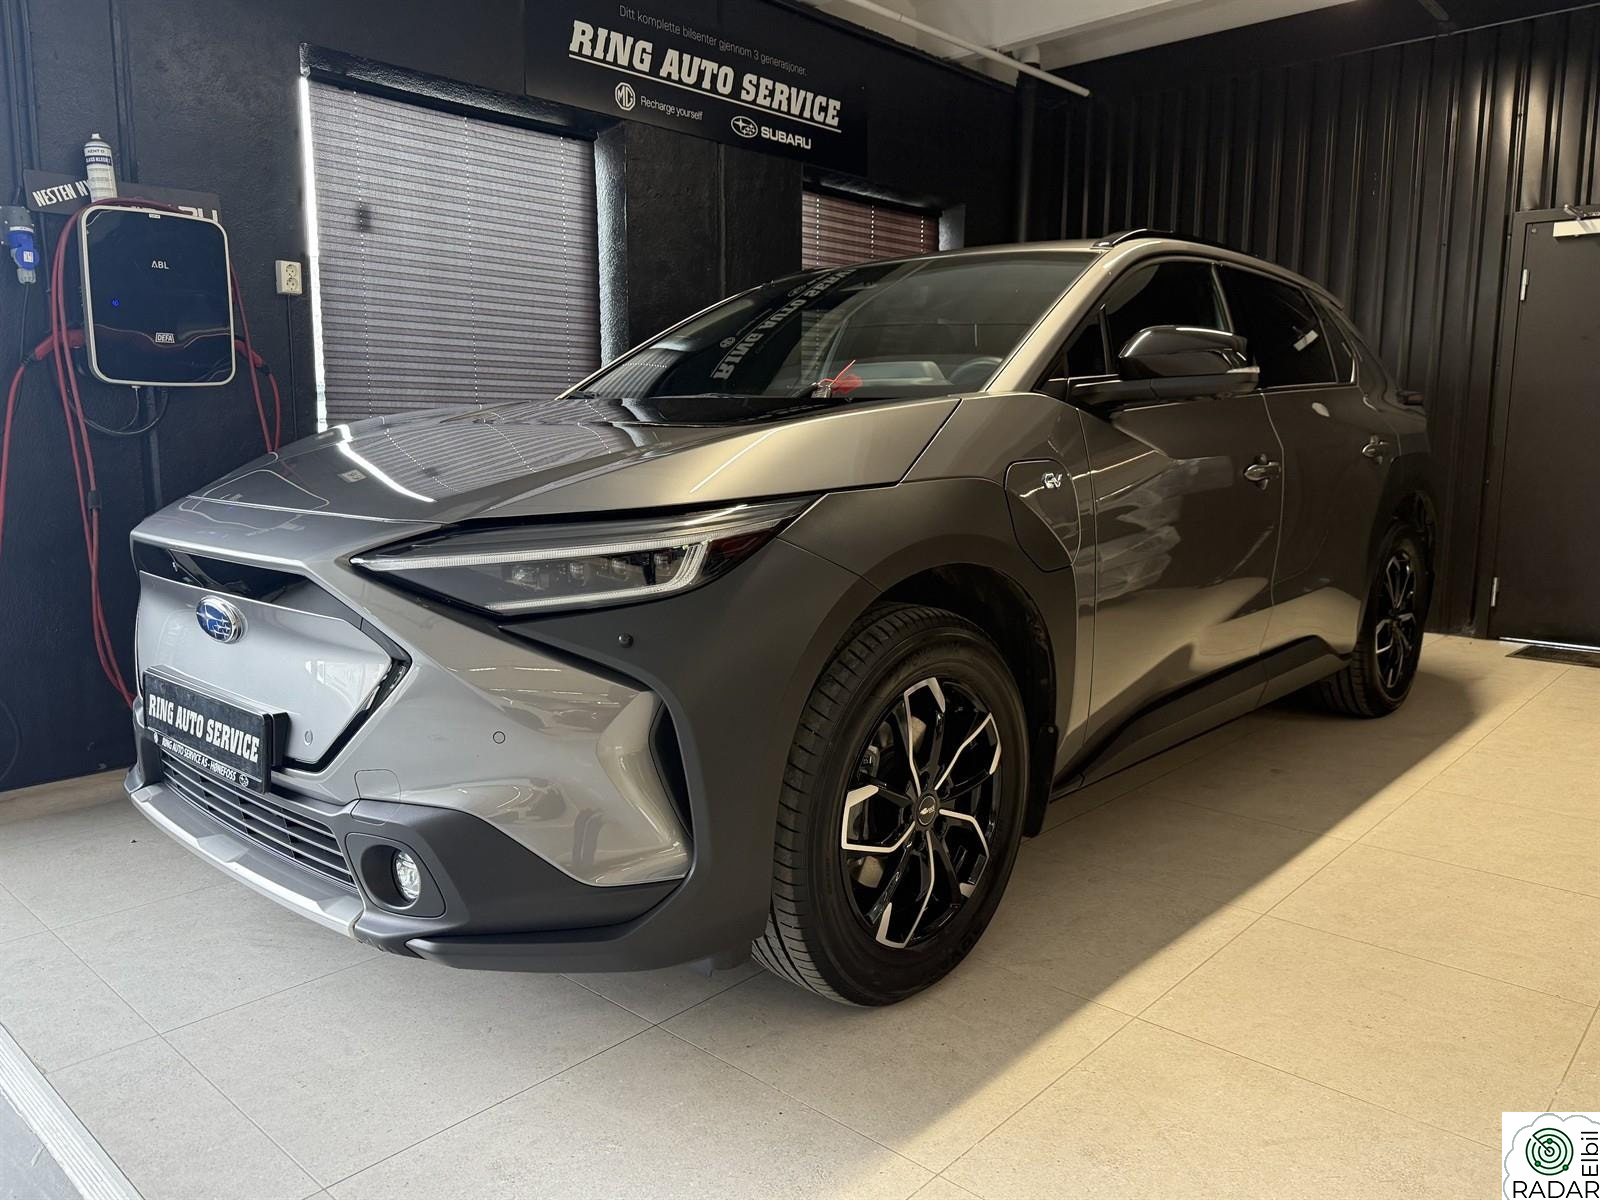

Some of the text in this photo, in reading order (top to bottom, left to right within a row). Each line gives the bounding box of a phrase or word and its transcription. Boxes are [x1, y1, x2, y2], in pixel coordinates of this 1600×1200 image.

[620, 5, 635, 20] Ditt
[637, 10, 681, 35] komplette
[682, 25, 717, 46] bilsenter
[719, 40, 753, 60] gjennom
[753, 49, 760, 61] 3
[569, 19, 841, 127] RING AUTO SERVICE
[615, 83, 635, 110] MG
[640, 95, 703, 121] Recharge yourself
[760, 126, 812, 149] SUBARU
[32, 183, 77, 207] NESTEN
[151, 260, 169, 269] ABL
[156, 333, 174, 343] DEFA
[149, 694, 260, 764] RING AUTO SERVICE
[162, 737, 173, 749] RING
[173, 742, 184, 755] AUTO
[184, 748, 201, 764] SERVICE
[201, 756, 208, 767] AS
